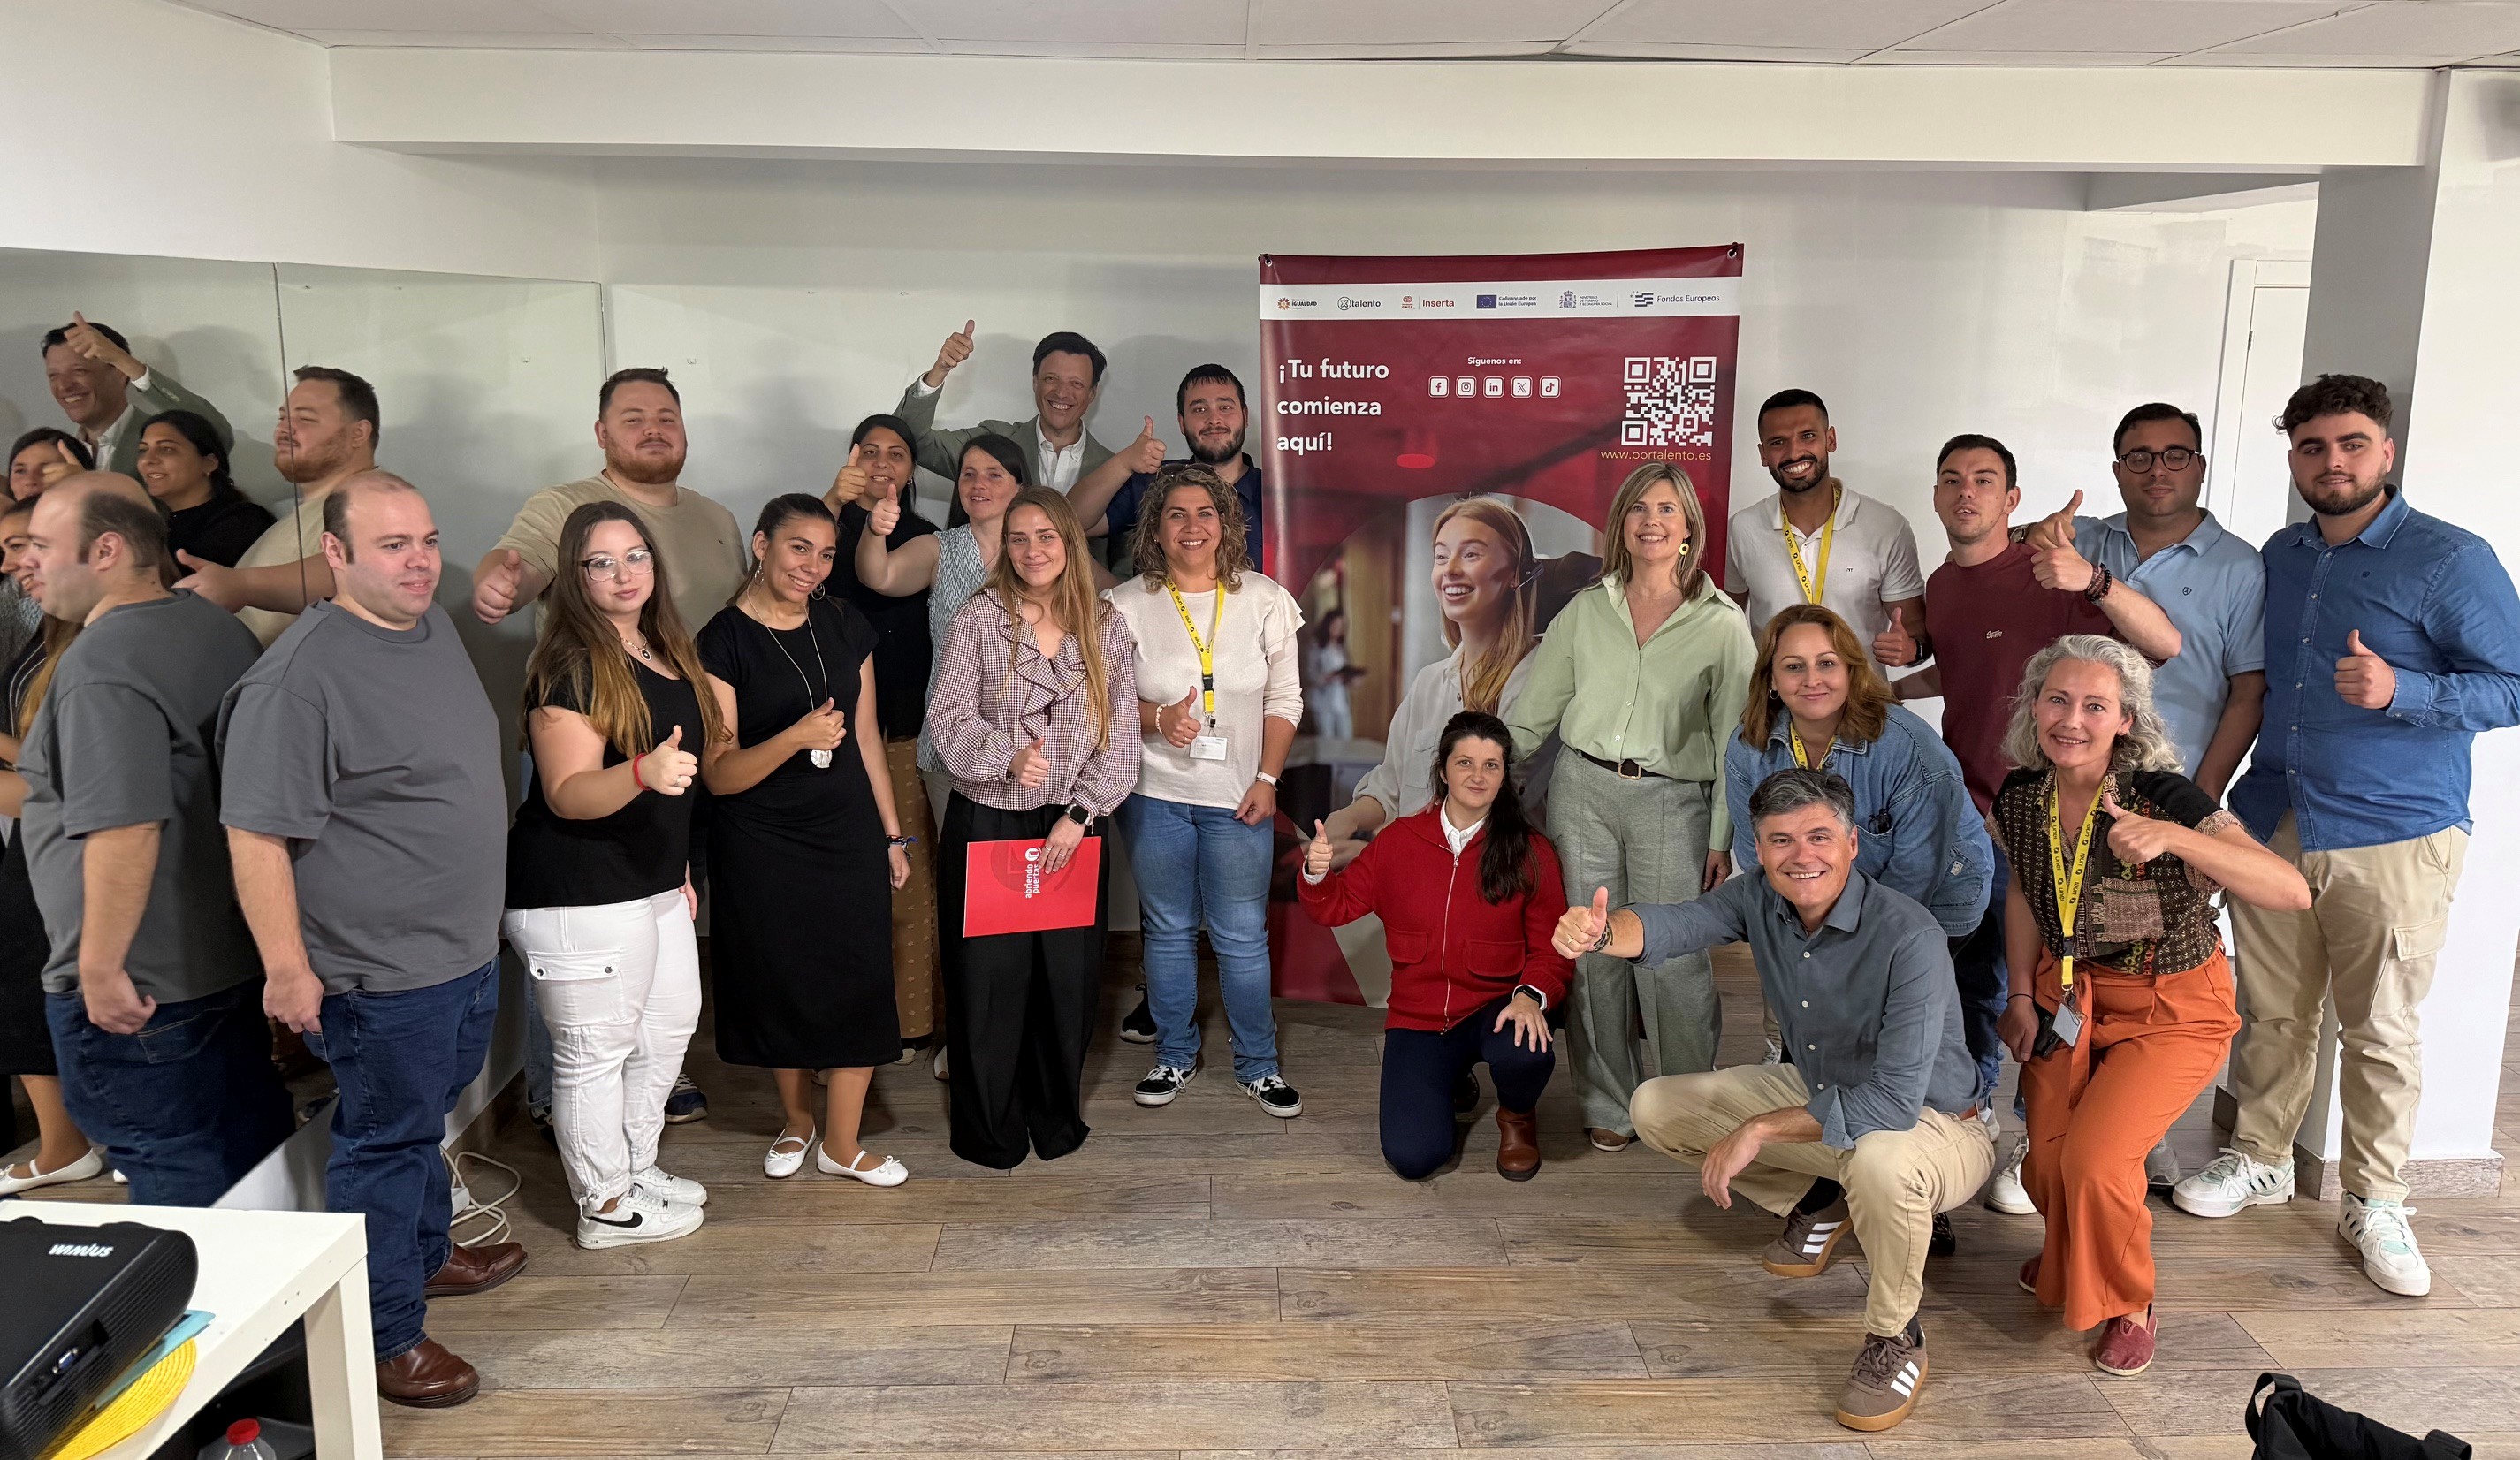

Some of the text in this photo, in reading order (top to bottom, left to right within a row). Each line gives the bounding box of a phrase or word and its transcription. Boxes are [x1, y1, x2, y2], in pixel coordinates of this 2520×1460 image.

[1422, 299, 1455, 308] Inserta
[1656, 293, 1720, 303] Fondos Europeos
[1467, 356, 1506, 367] Síguenos
[1279, 357, 1389, 384] ¡Tu futuro
[1276, 395, 1382, 415] comienza
[1276, 432, 1332, 456] aquí!
[1600, 448, 1712, 462] www.portalento.es
[1024, 863, 1034, 899] abriendo
